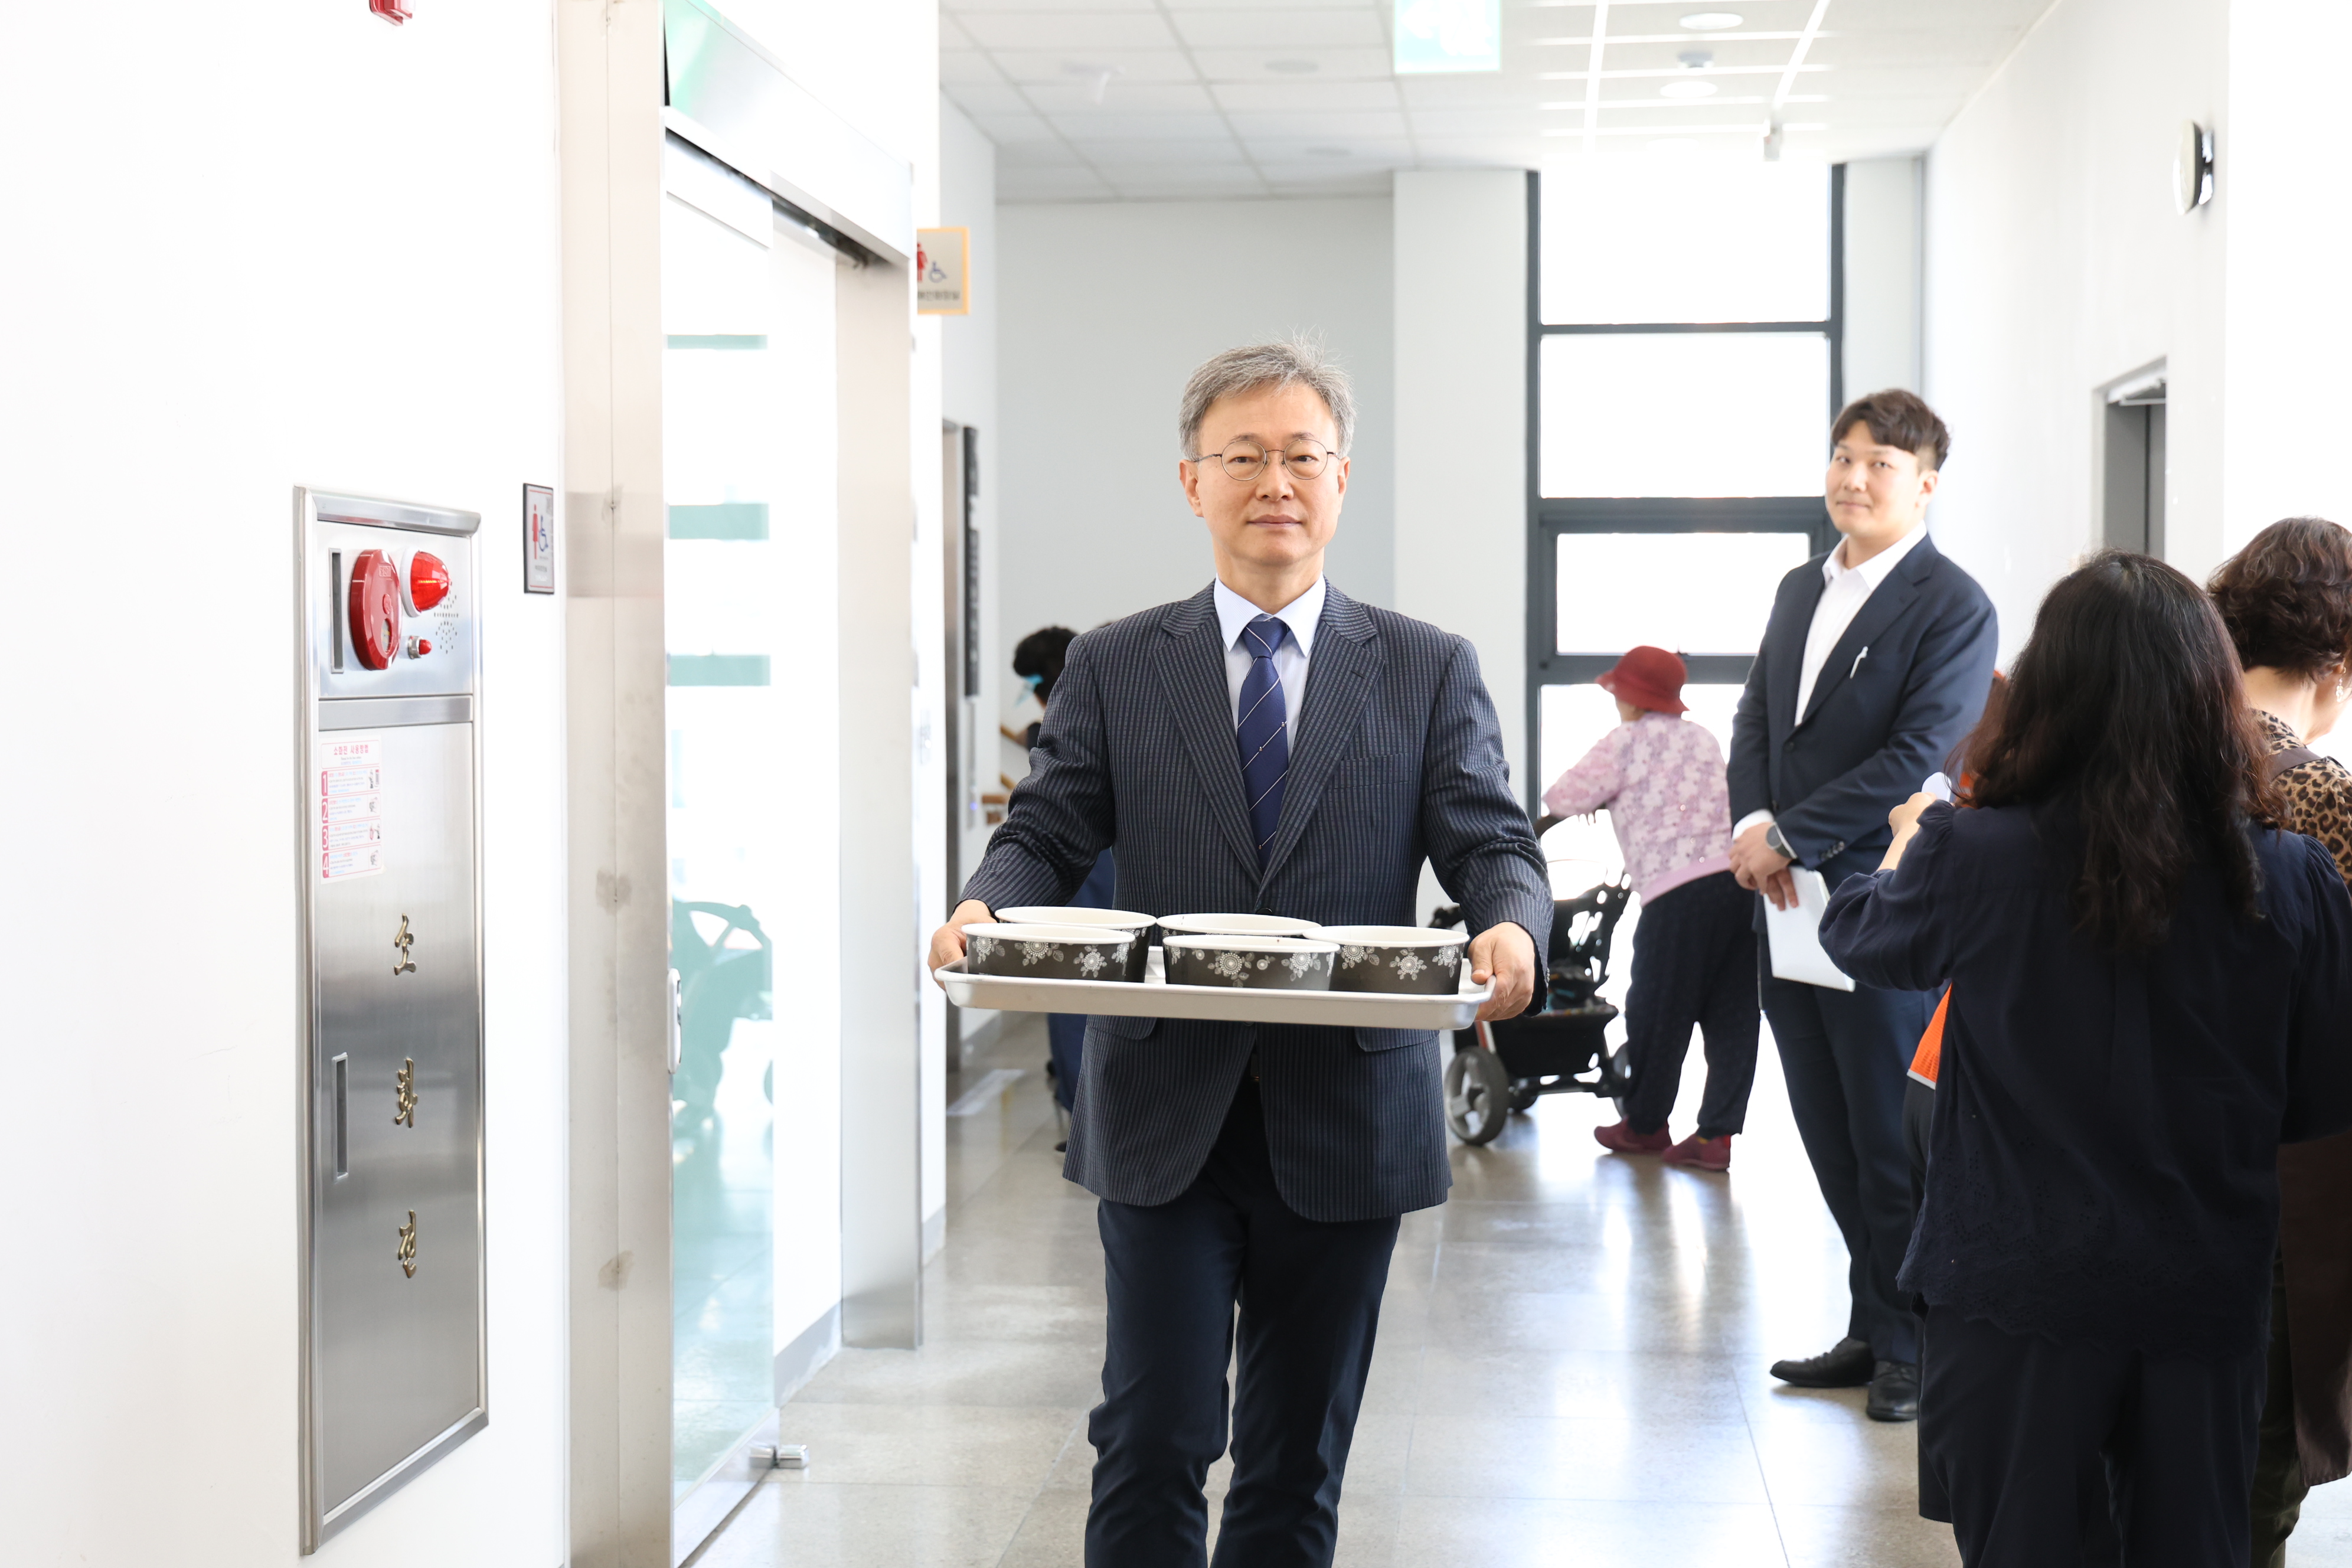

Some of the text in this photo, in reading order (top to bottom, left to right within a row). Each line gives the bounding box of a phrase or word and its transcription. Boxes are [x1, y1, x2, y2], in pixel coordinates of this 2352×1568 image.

[334, 744, 368, 755] 소화전 사용방법
[322, 774, 327, 793] 1
[322, 801, 328, 821] 2
[322, 828, 328, 848] 3
[323, 855, 329, 875] 4
